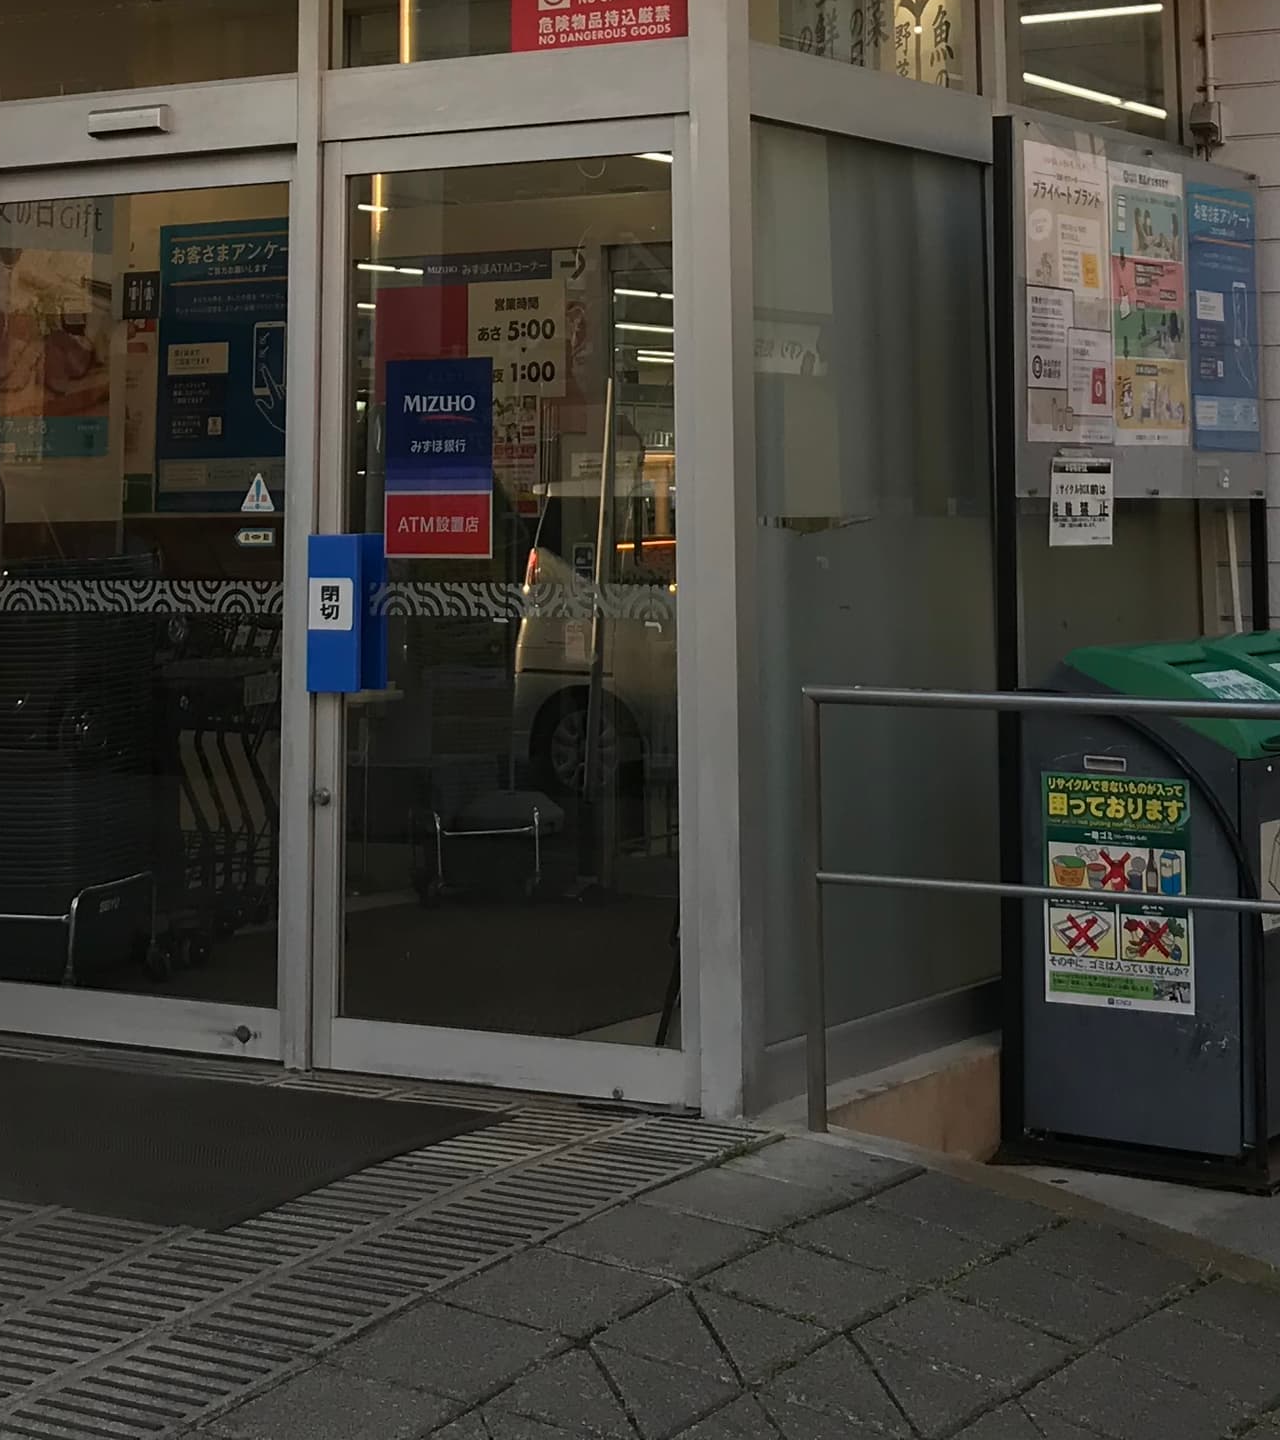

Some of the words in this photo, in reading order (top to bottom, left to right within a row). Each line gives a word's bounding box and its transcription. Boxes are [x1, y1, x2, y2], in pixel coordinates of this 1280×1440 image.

[539, 5, 670, 34] 危険物品持込厳禁
[539, 35, 555, 45] NO
[560, 27, 627, 43] DANGEROUS
[631, 24, 671, 37] GOODS
[494, 296, 539, 312] 営業時間
[477, 326, 501, 342] あさ
[507, 319, 556, 341] 5:00
[510, 361, 556, 383] 1:00
[403, 395, 476, 414] MIZUHO
[410, 439, 466, 453] みずほ銀行
[398, 516, 479, 533] ATM設置店
[320, 585, 339, 620] 閉切
[1048, 777, 1183, 797] リサイクルできないものが入って
[1048, 792, 1184, 822] 困っております
